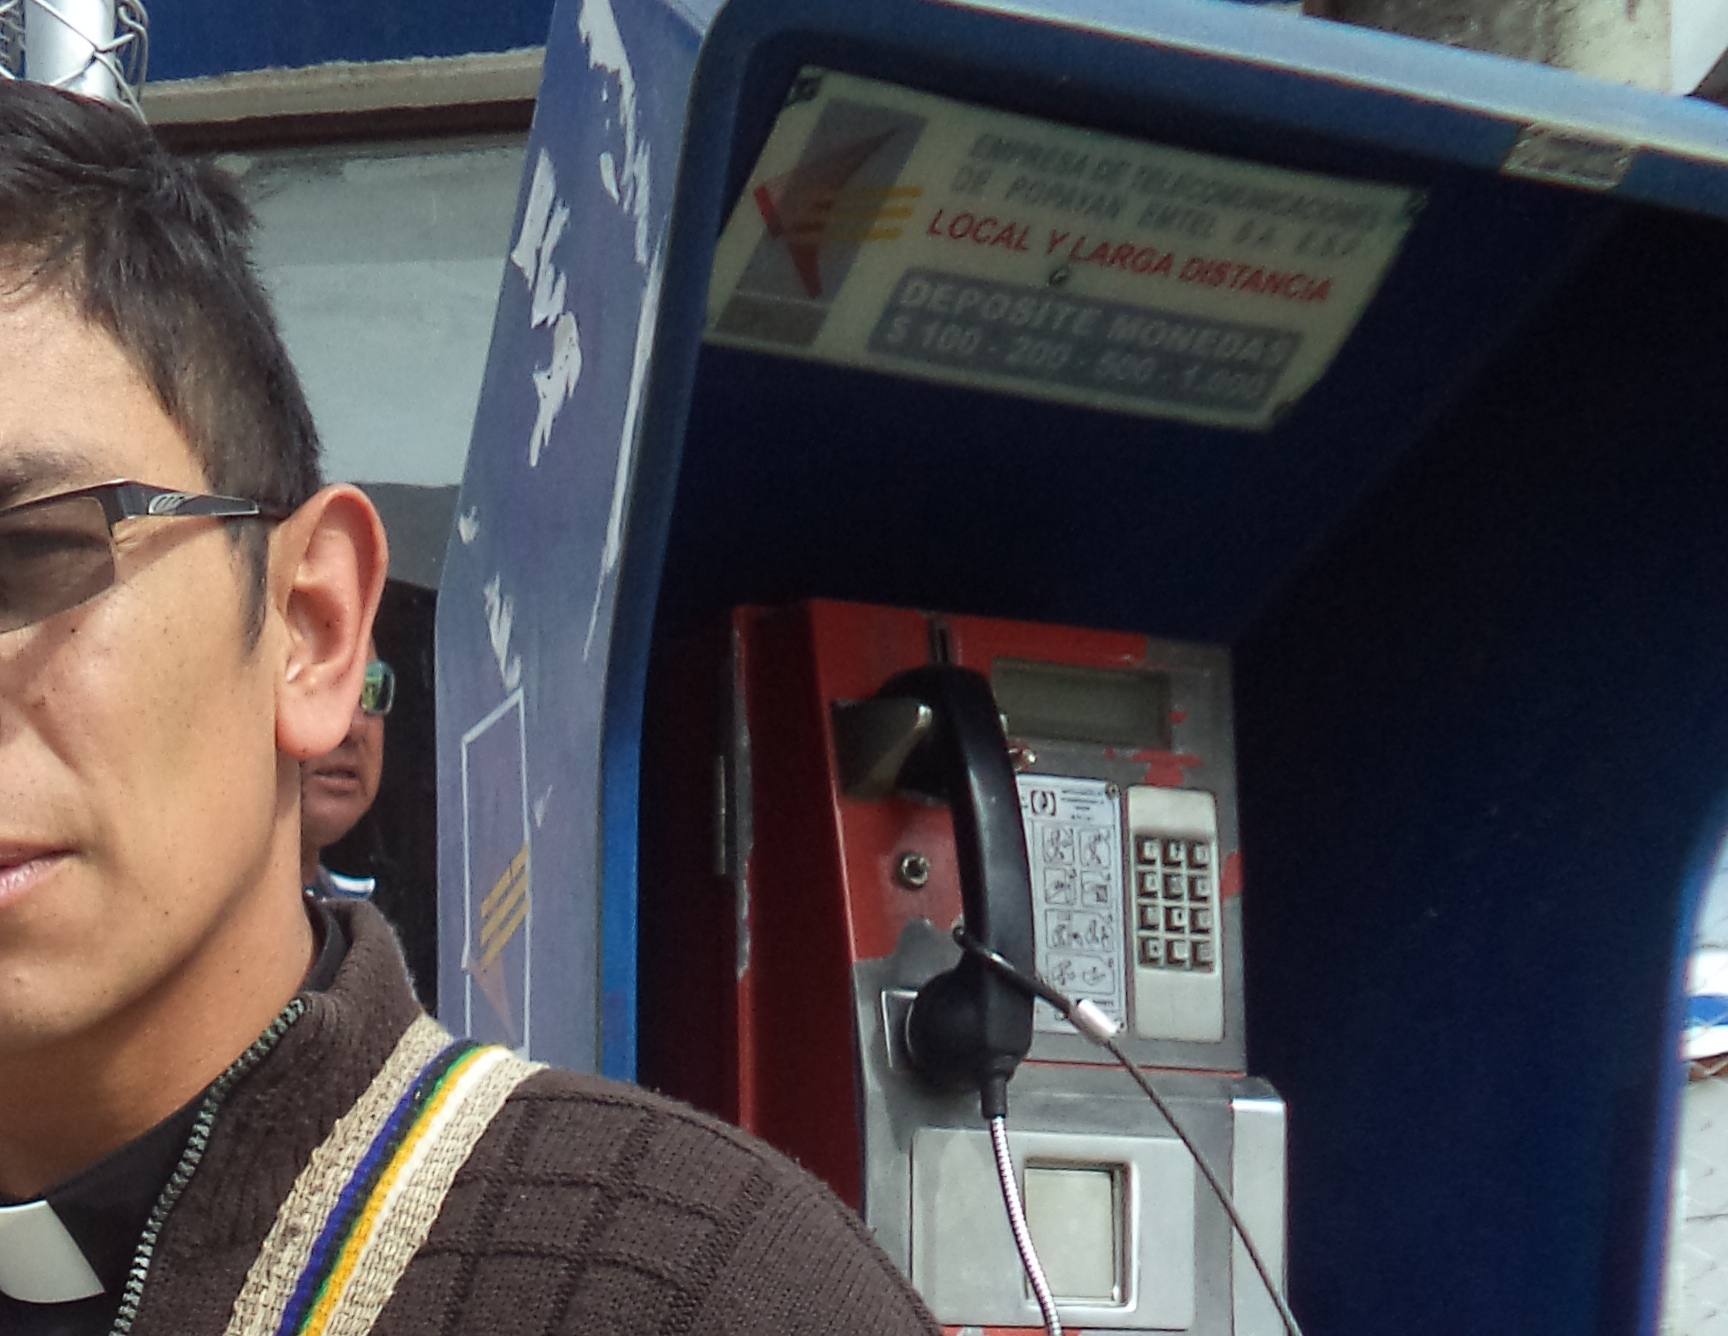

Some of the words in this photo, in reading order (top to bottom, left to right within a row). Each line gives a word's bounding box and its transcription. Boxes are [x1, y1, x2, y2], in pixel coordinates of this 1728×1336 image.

[926, 208, 1031, 252] LOCAL
[1047, 228, 1071, 255] Y
[1068, 235, 1173, 280] LARGA
[1178, 256, 1334, 302] DISTANCIA
[899, 277, 1103, 336] DEPOSITE
[1106, 312, 1292, 368] MONEDAS
[921, 320, 983, 357] 100
